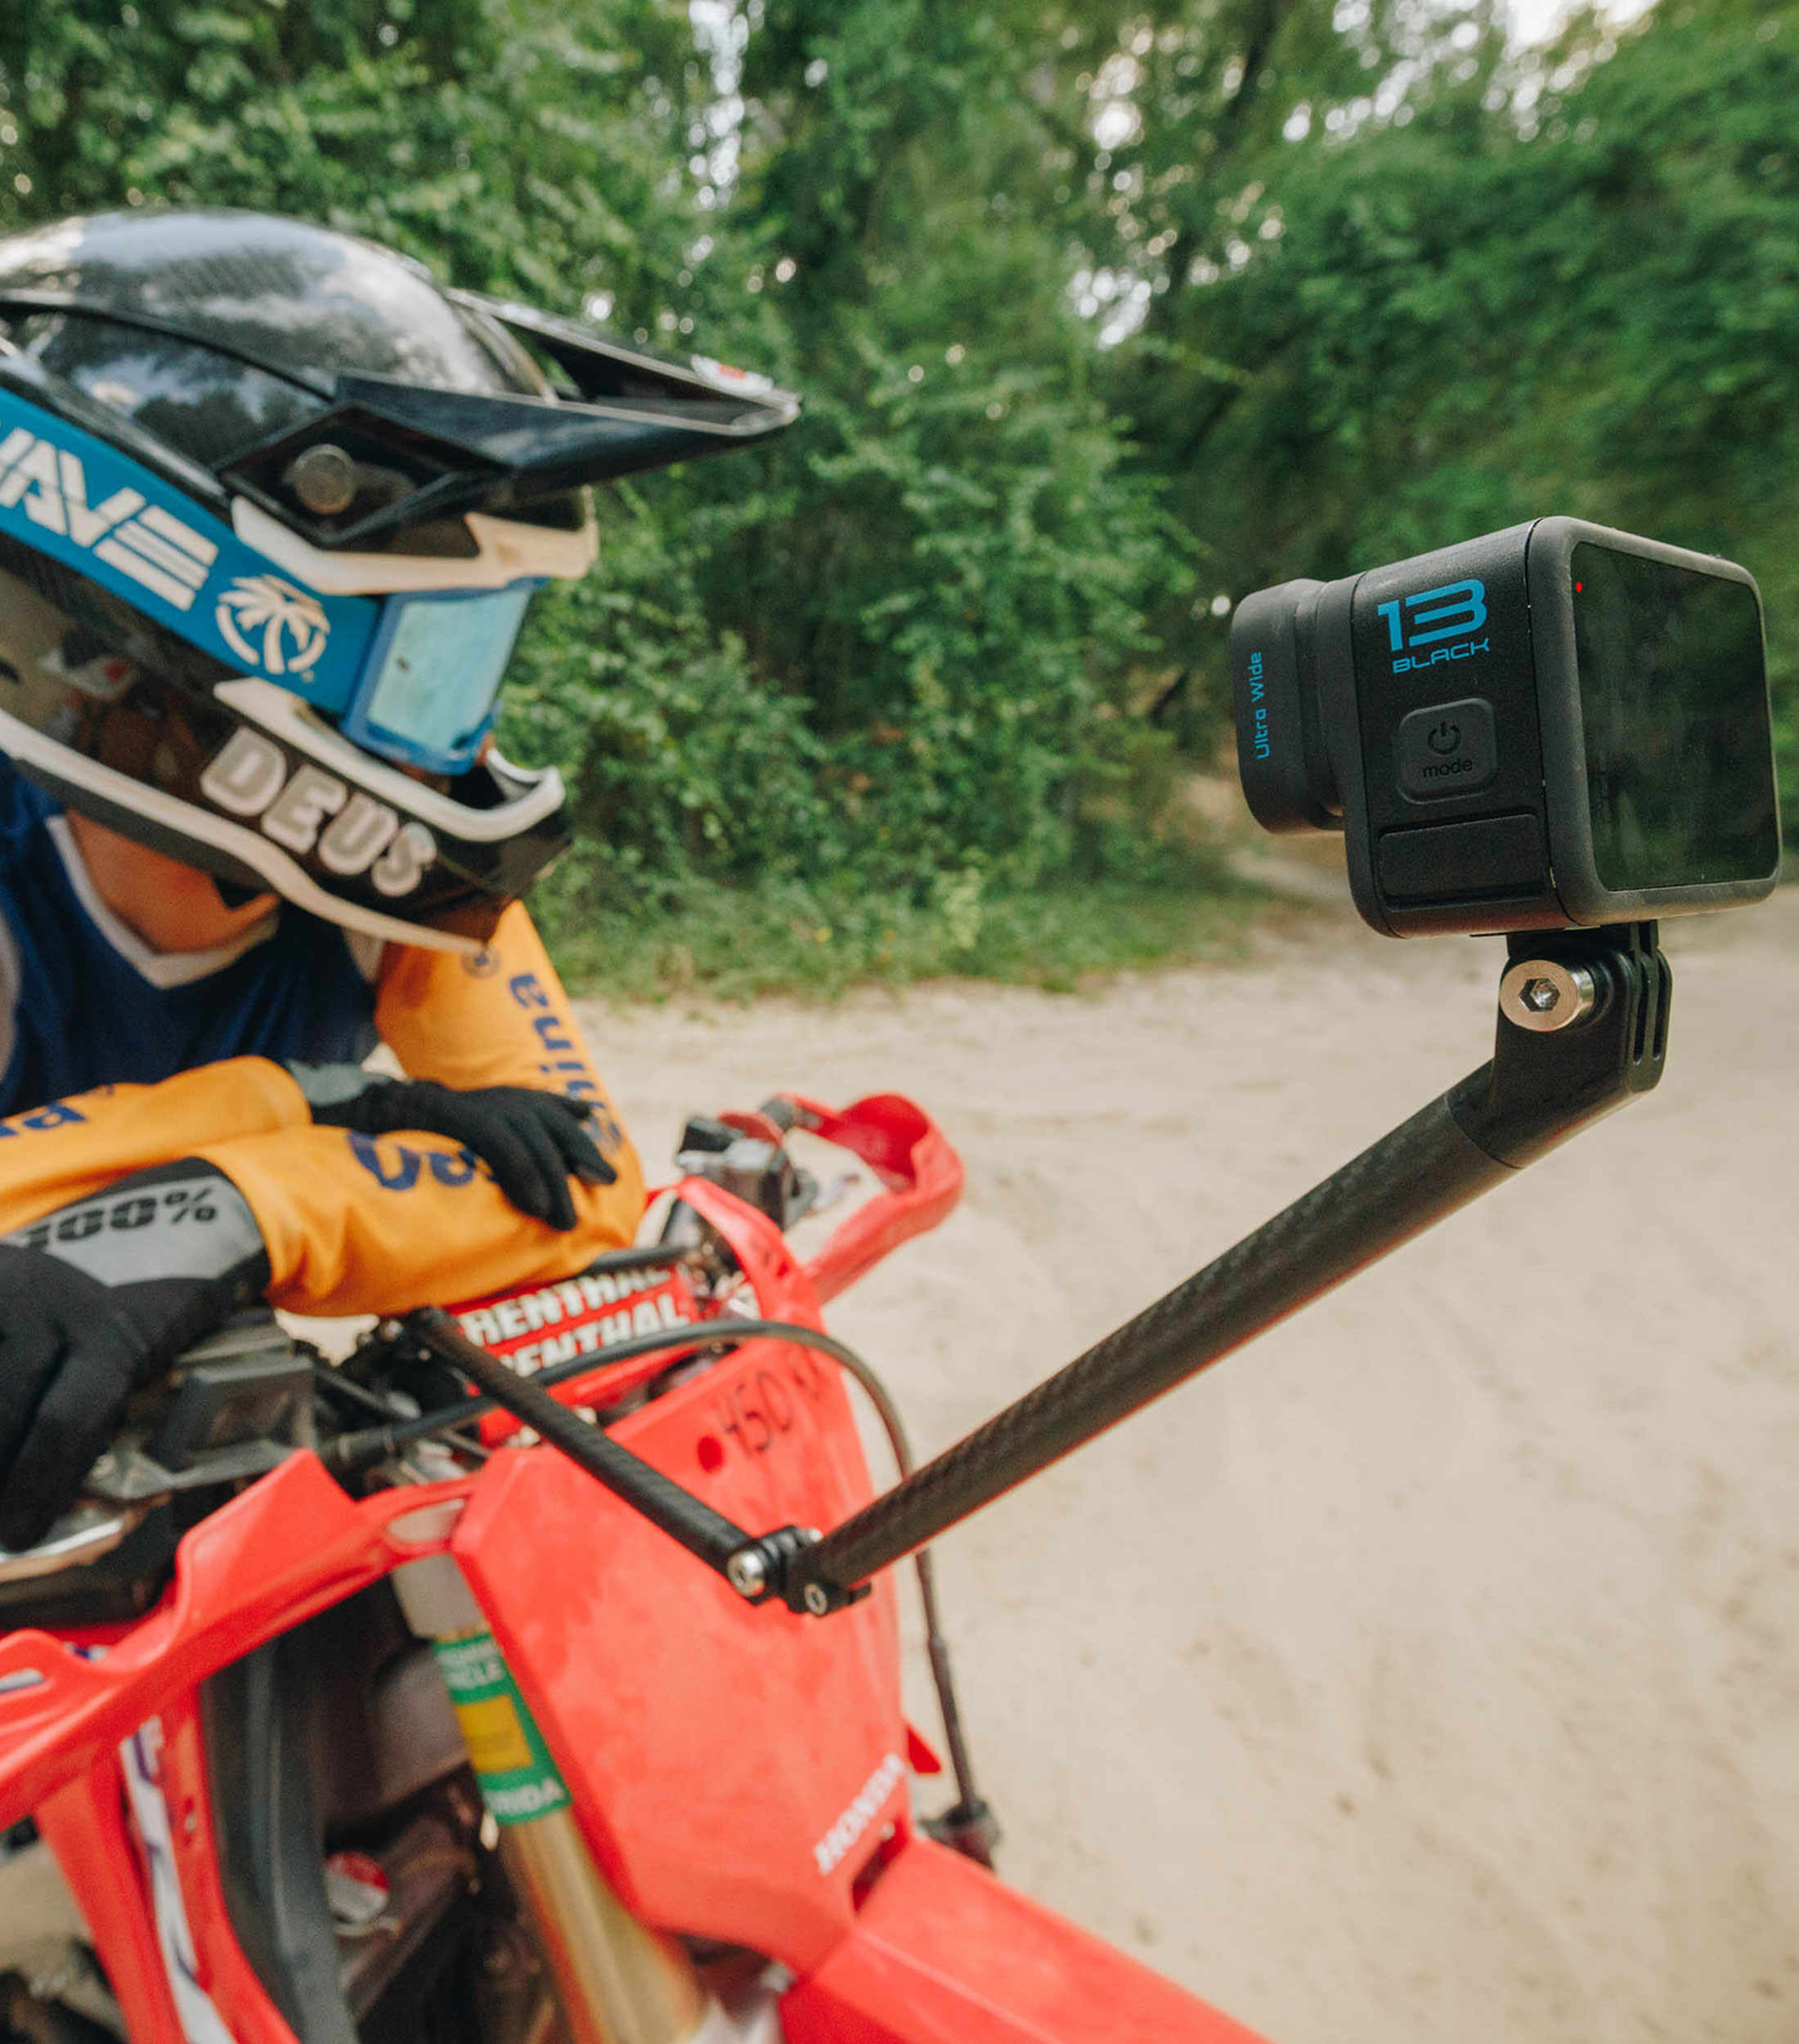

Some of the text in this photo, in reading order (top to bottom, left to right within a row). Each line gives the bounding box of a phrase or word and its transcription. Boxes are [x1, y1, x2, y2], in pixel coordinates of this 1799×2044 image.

[1377, 578, 1487, 652] 13
[1392, 637, 1491, 675] BLACK
[1247, 652, 1270, 760] Ultra Wide
[1422, 757, 1474, 778] mode
[199, 724, 437, 897] DEUS
